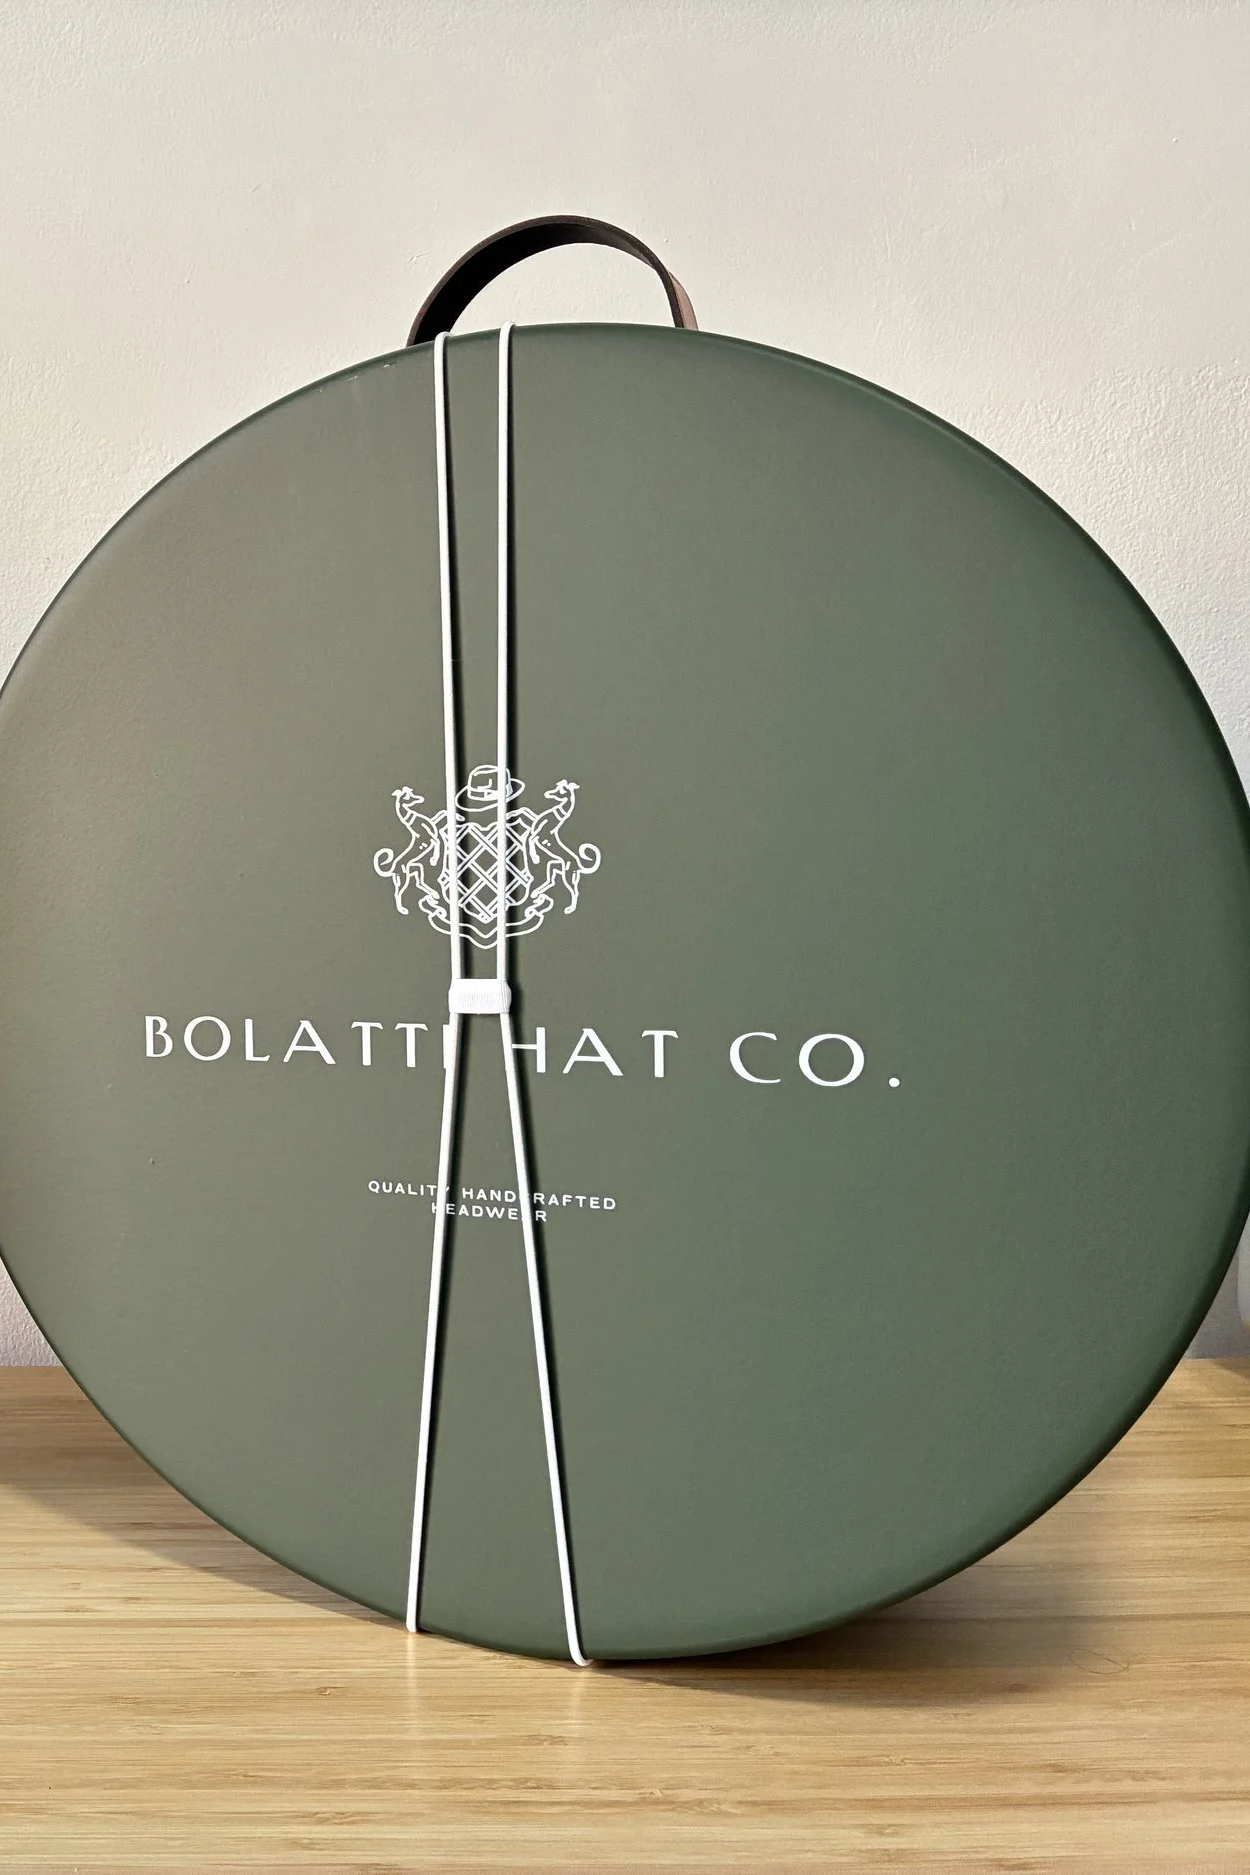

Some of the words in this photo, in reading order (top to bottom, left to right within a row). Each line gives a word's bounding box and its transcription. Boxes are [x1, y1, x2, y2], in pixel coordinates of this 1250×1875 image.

[144, 1015, 452, 1070] BOLATTI
[729, 1031, 900, 1088] CO.
[368, 1180, 450, 1197] QUALIT
[462, 1187, 616, 1210] HANDRAFTED
[431, 1202, 547, 1222] EADWER
